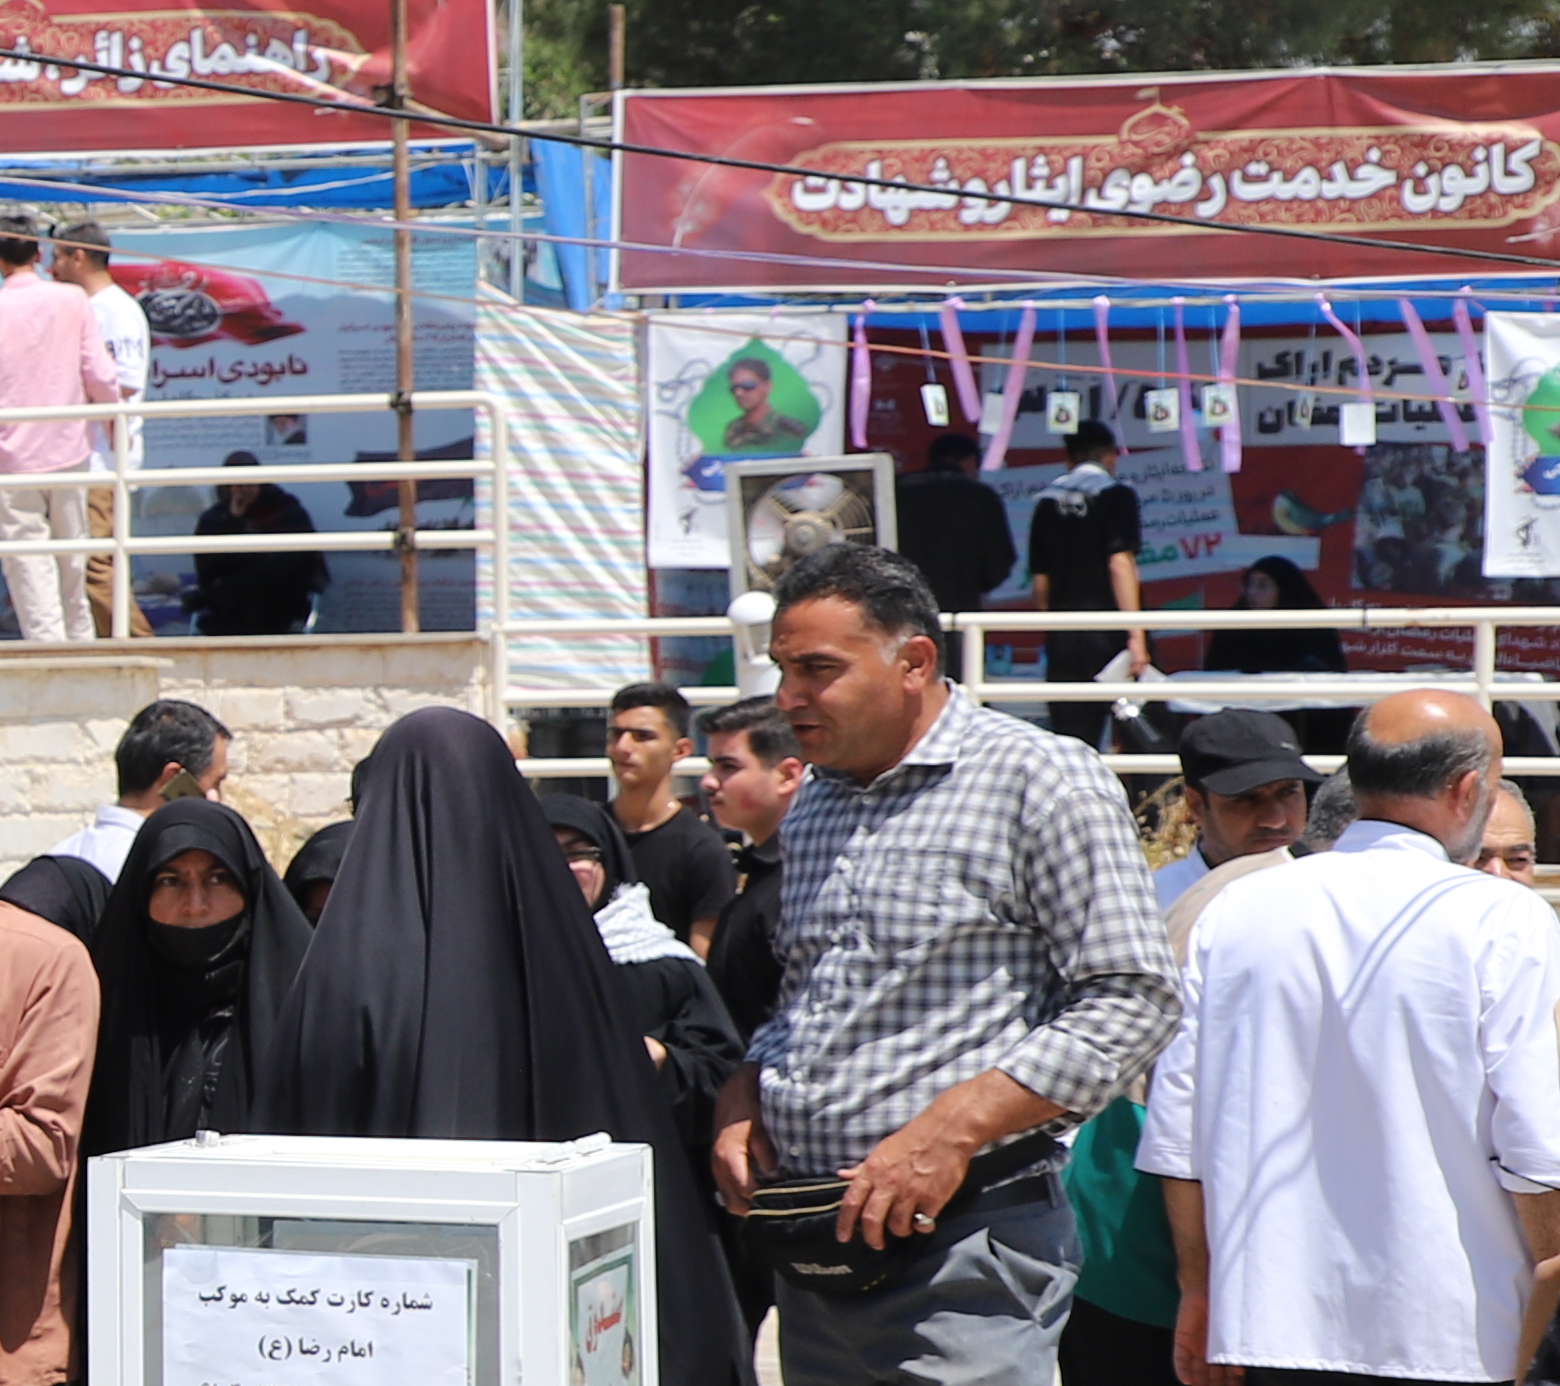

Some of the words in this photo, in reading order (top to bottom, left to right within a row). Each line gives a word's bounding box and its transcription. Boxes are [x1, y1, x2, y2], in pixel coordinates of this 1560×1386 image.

[149, 27, 332, 87] راهنمای
[1085, 148, 1229, 218] رضوی
[1231, 143, 1399, 203] خدمت
[1402, 138, 1543, 213] کانون
[790, 156, 961, 227] شهادت
[150, 356, 216, 388] اسرا
[221, 354, 308, 385] نابودی
[198, 1284, 248, 1310] موکب
[253, 1290, 271, 1310] به
[275, 1288, 321, 1306] کمک
[326, 1289, 375, 1314] کارت
[380, 1290, 434, 1315] شماره
[257, 1334, 293, 1361] (ع)
[297, 1336, 332, 1362] رضا
[336, 1340, 374, 1363] امام
